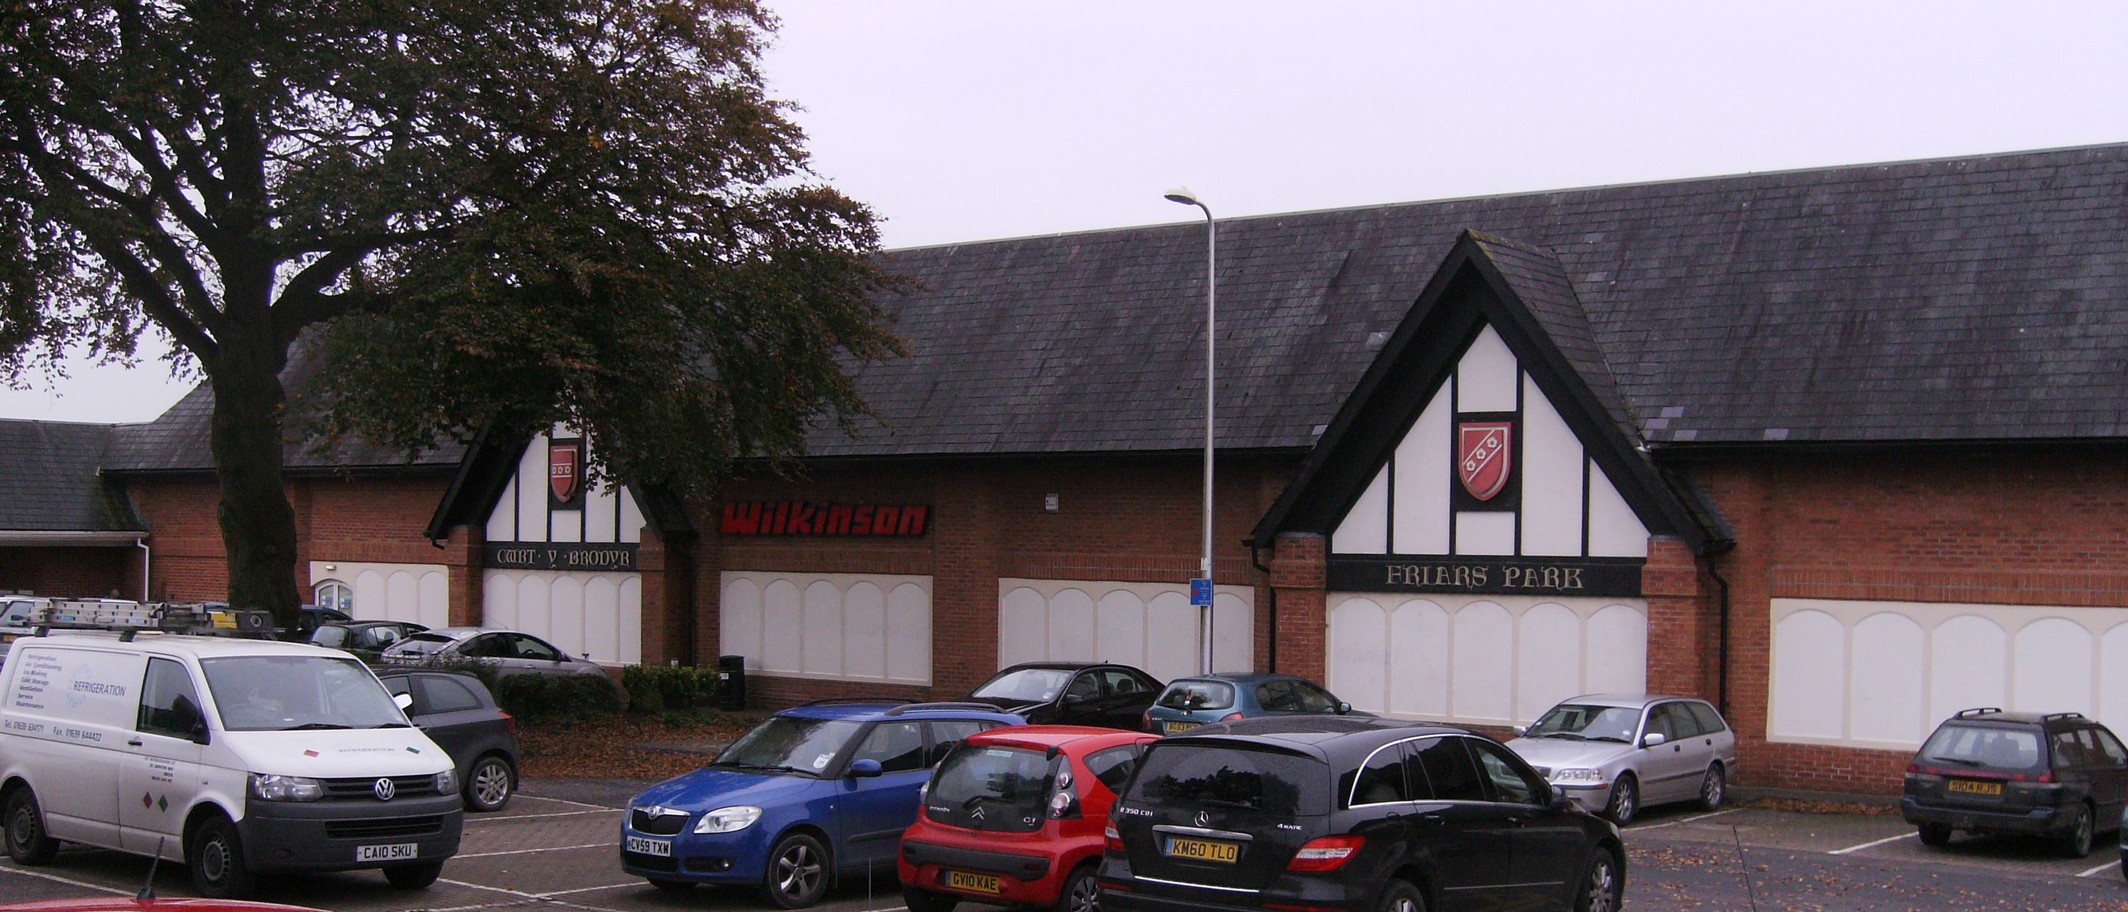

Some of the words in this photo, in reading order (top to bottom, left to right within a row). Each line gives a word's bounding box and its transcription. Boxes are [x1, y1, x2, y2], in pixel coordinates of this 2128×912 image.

[719, 501, 927, 535] Wilkinson
[1385, 564, 1489, 590] FRIARS
[1502, 565, 1585, 591] PARK
[73, 680, 127, 697] REFRIGERATION
[391, 845, 412, 857] SKU
[631, 838, 650, 852] CV59
[652, 841, 670, 855] TXW
[1173, 839, 1206, 857] KM60
[1210, 844, 1236, 860] TLO
[953, 873, 975, 886] GV10
[976, 875, 997, 890] KAE
